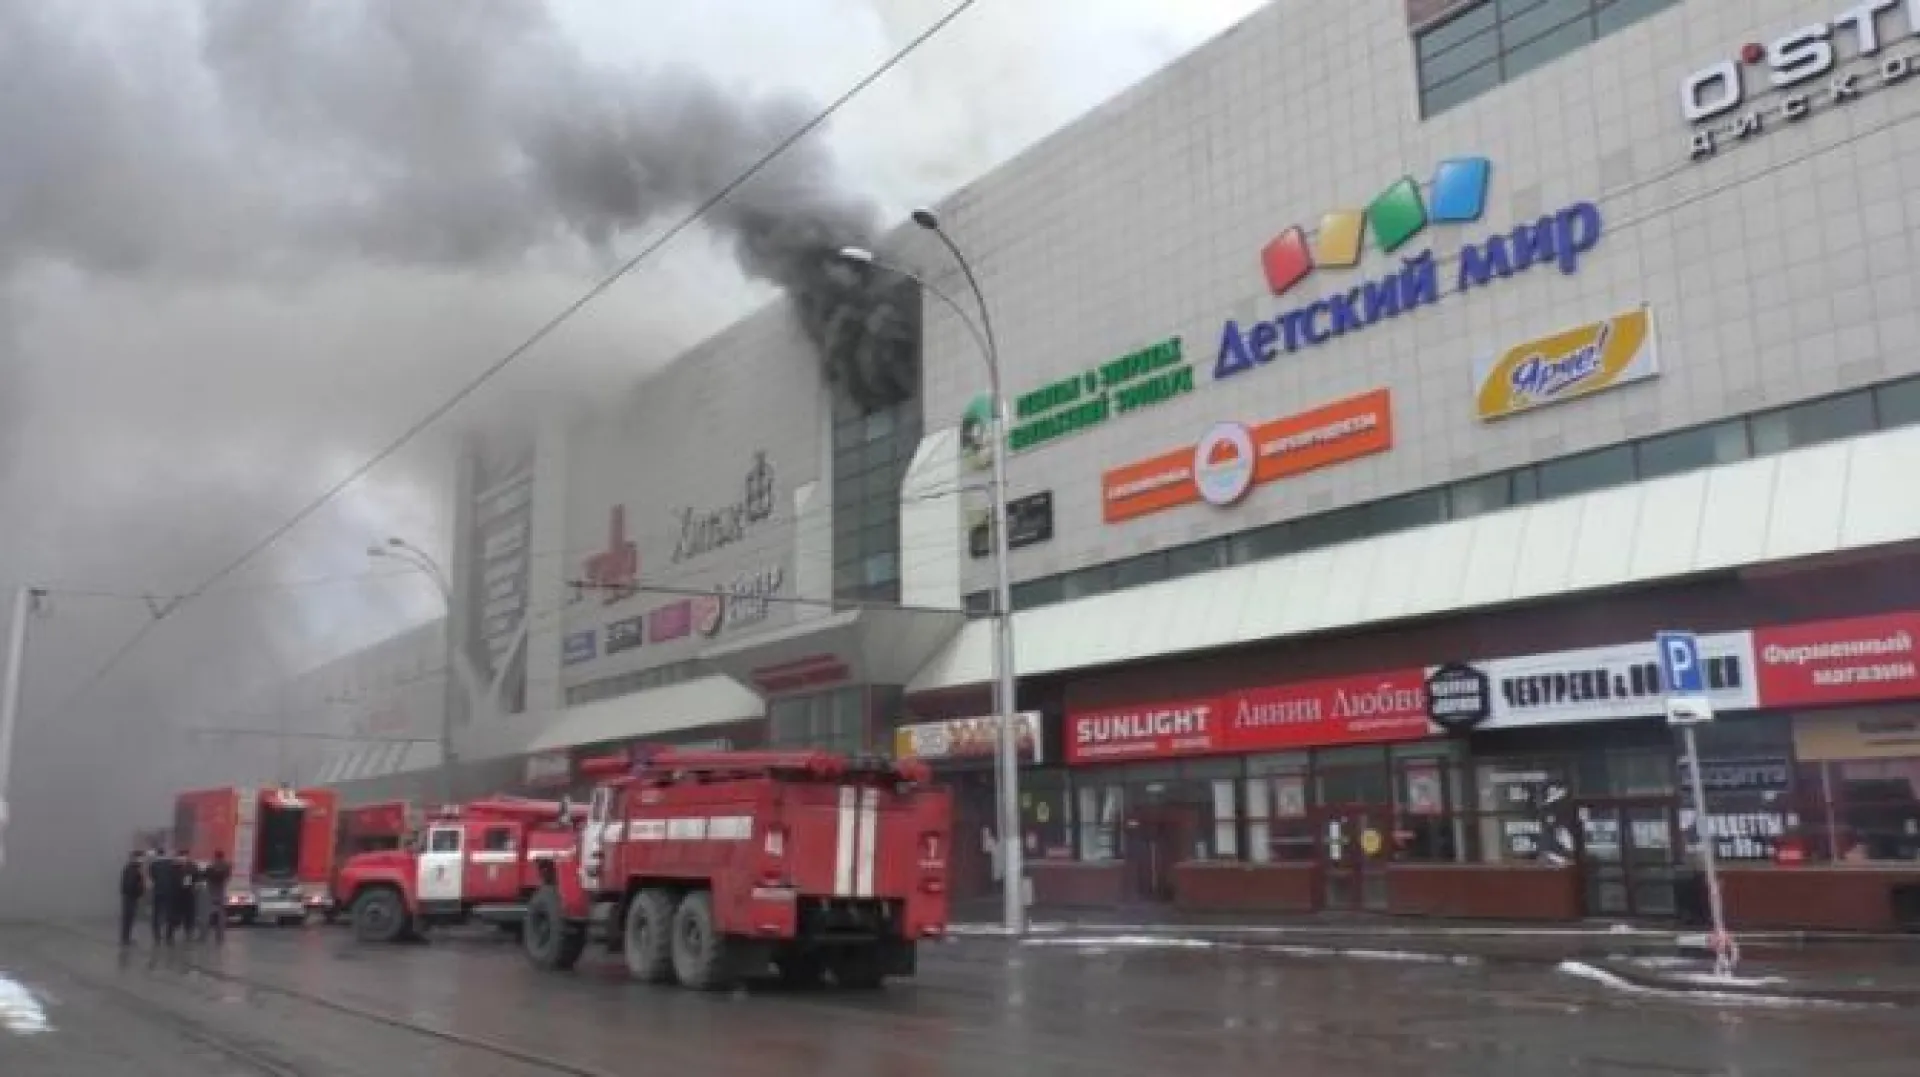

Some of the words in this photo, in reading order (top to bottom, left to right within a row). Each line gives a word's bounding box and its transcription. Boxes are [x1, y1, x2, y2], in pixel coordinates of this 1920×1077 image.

[1212, 248, 1438, 379] Детский
[1458, 201, 1601, 293] мир
[1667, 640, 1692, 688] P
[1764, 630, 1913, 665] Фирменный
[1501, 667, 1611, 708] ЧЕБУРЕКИ
[1811, 661, 1916, 686] магазин
[1076, 704, 1212, 743] SUNLIGHT
[1234, 696, 1322, 729] Линии
